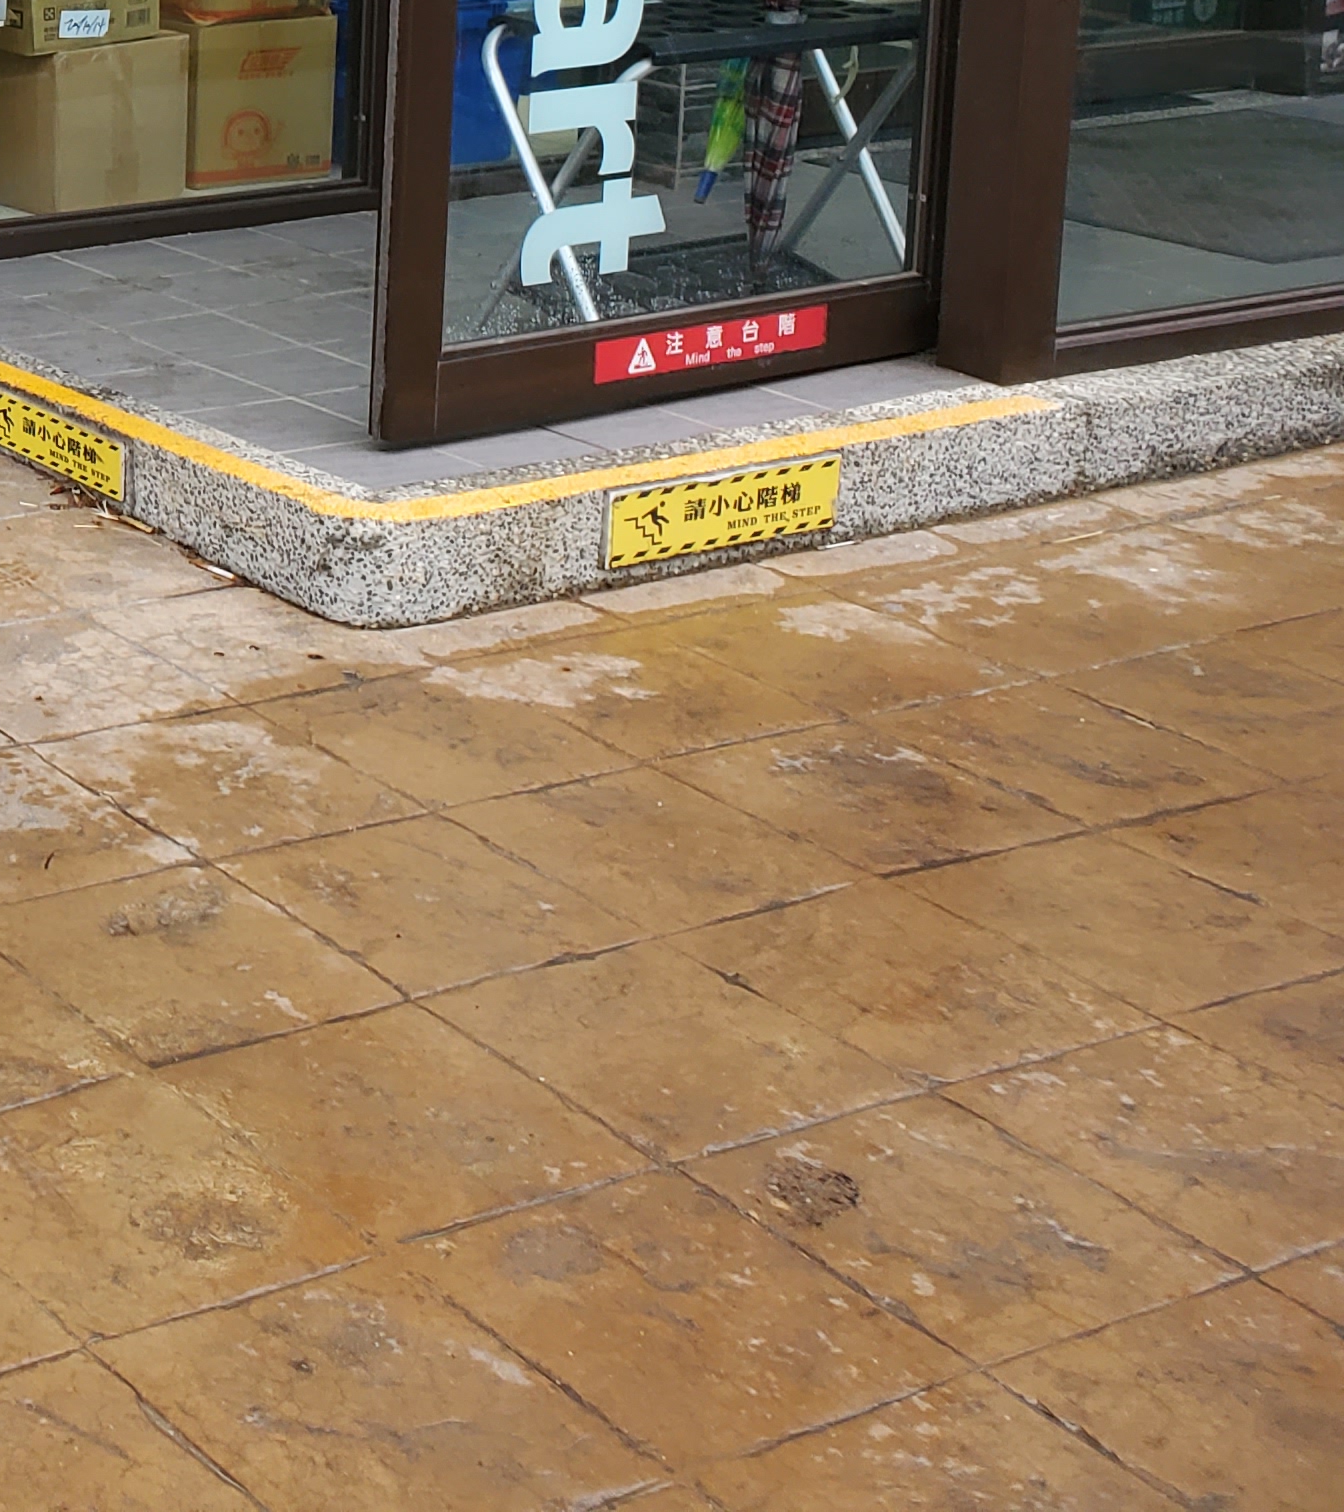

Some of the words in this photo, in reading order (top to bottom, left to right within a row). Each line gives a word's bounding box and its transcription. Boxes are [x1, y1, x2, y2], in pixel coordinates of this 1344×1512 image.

[665, 312, 797, 356] 注意台階
[684, 350, 711, 366] Mind
[726, 346, 743, 359] the
[754, 341, 775, 354] step
[22, 416, 99, 465] 請小心階梯
[49, 448, 69, 464] MIND
[72, 459, 88, 473] THE
[91, 468, 111, 484] STEP
[683, 481, 802, 523] 請小心階梯
[726, 517, 758, 531] MIND
[764, 511, 788, 524] THE
[792, 504, 822, 520] STEP
